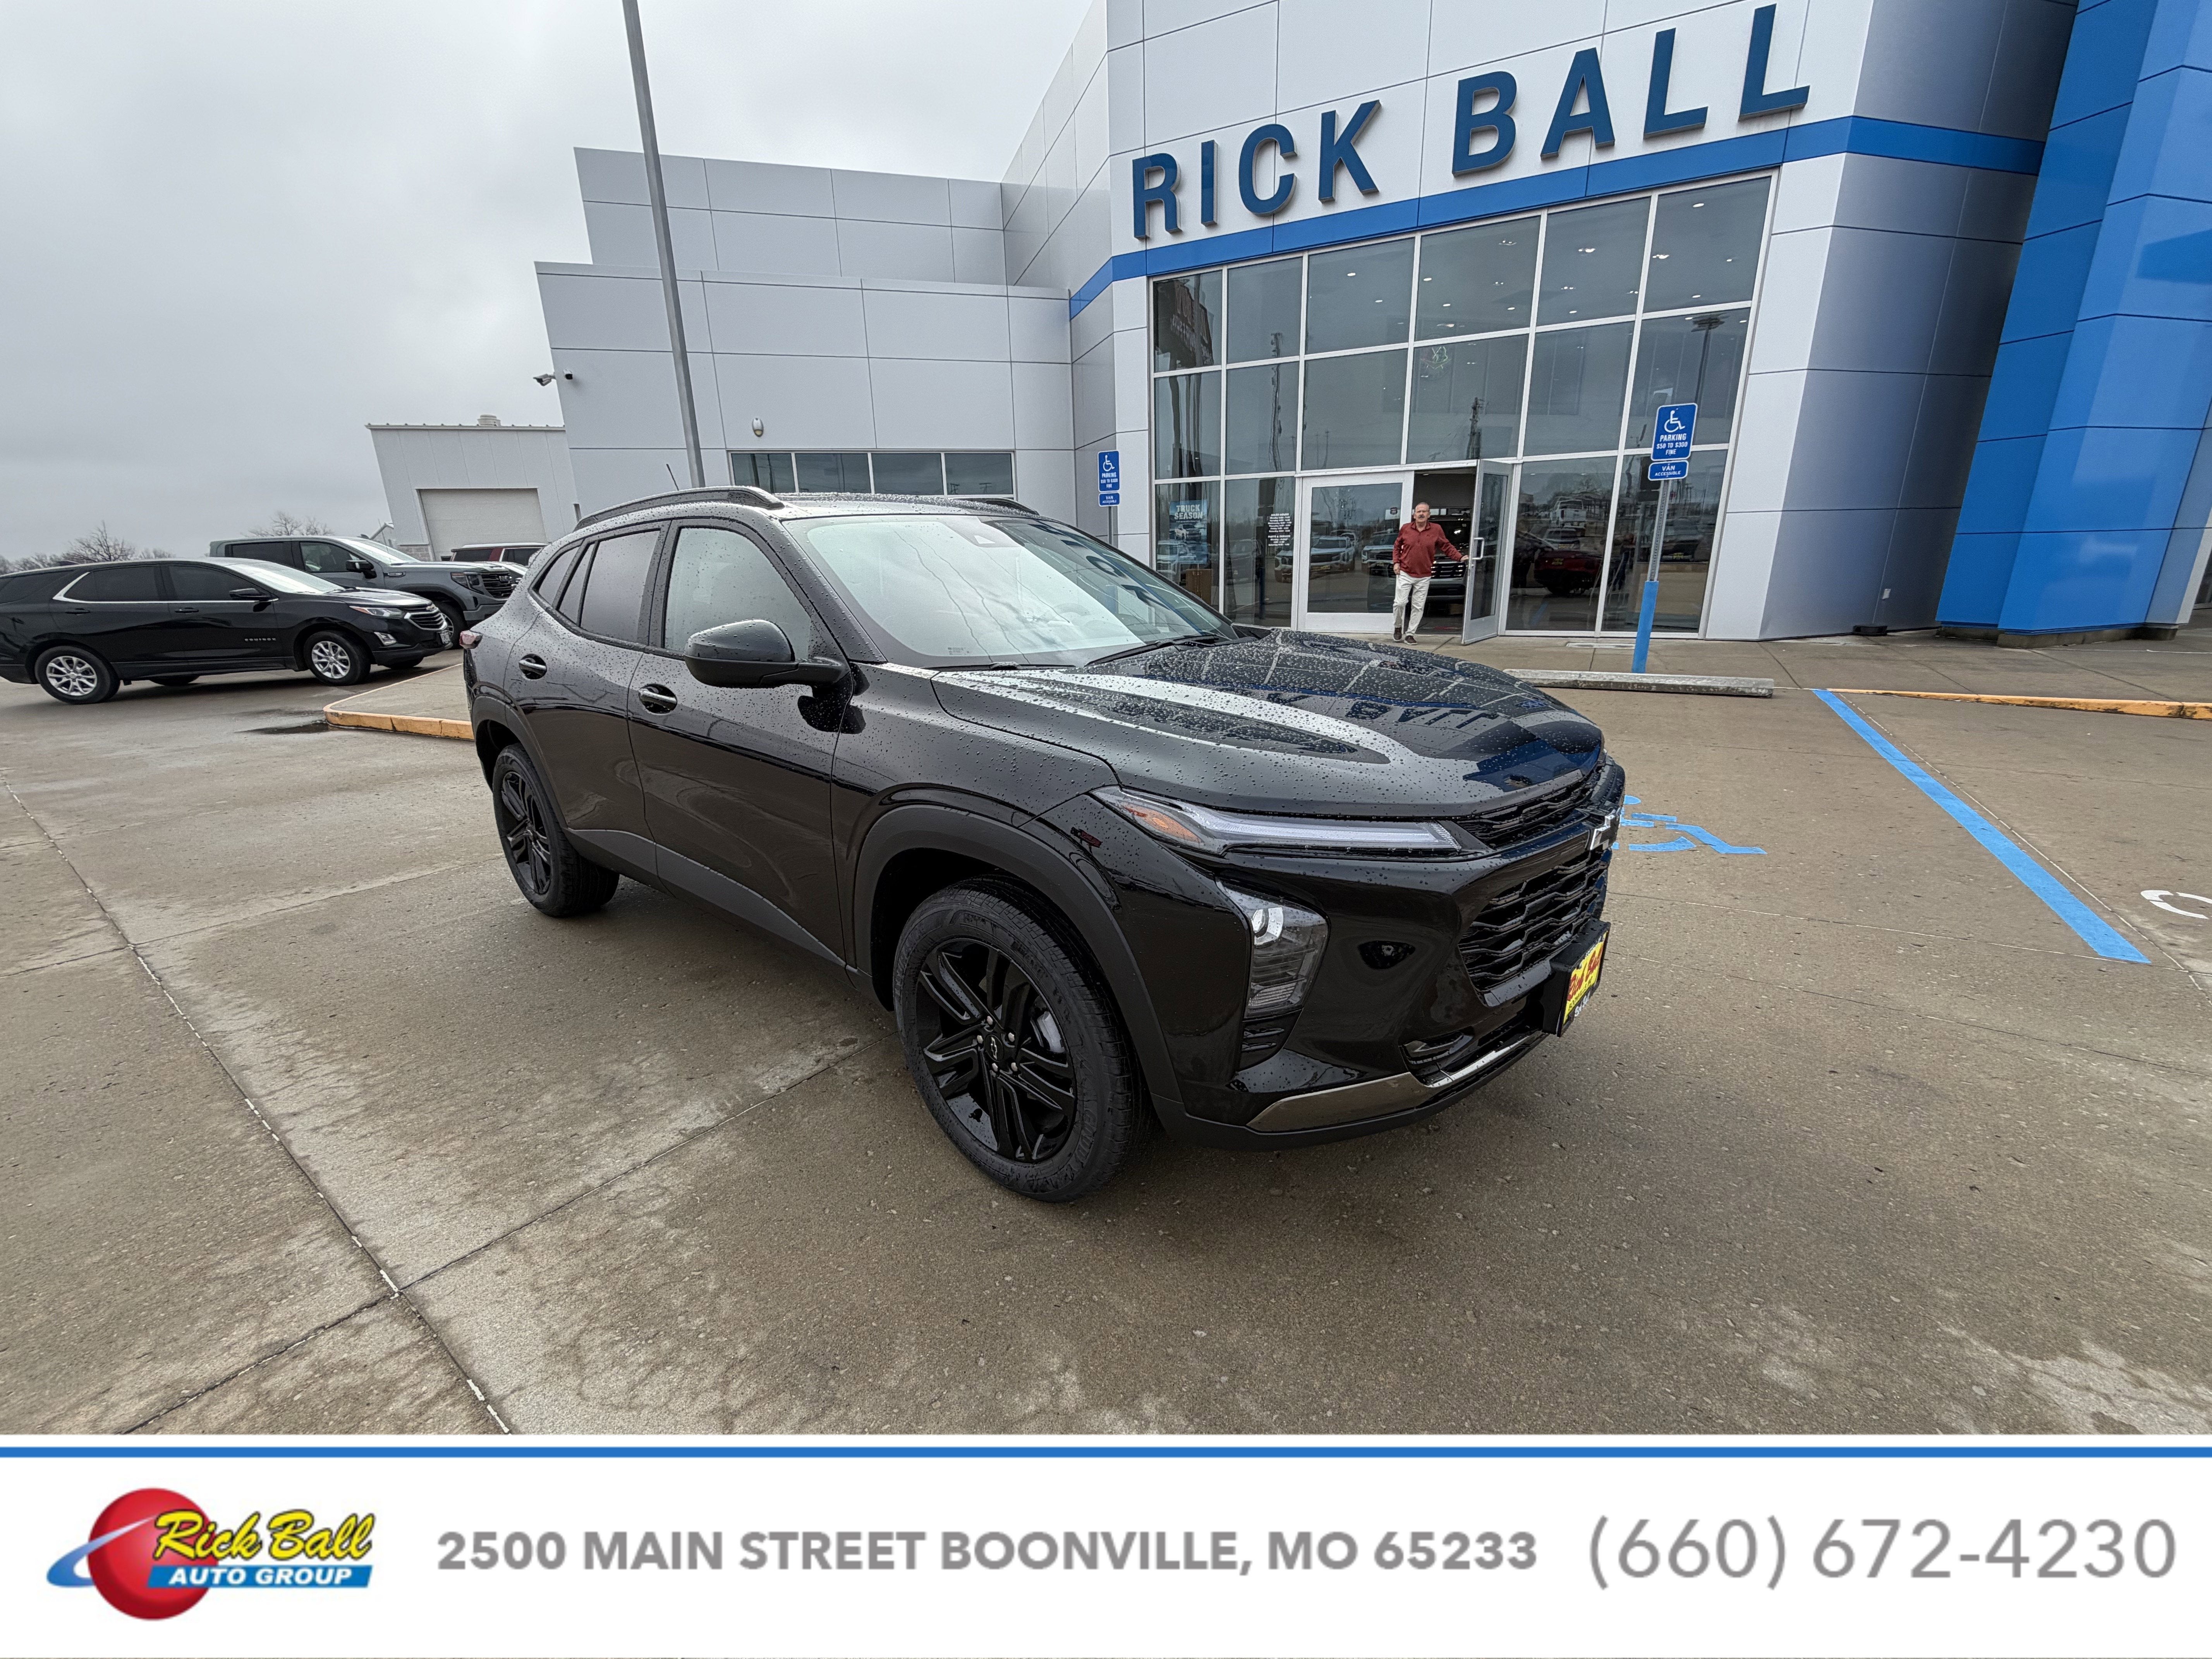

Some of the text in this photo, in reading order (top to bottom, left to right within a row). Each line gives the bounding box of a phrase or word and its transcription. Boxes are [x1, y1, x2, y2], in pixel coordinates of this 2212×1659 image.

[1132, 3, 1810, 240] RICK BALL
[1660, 433, 1686, 442] PARKING
[1174, 512, 1203, 520] SEASON
